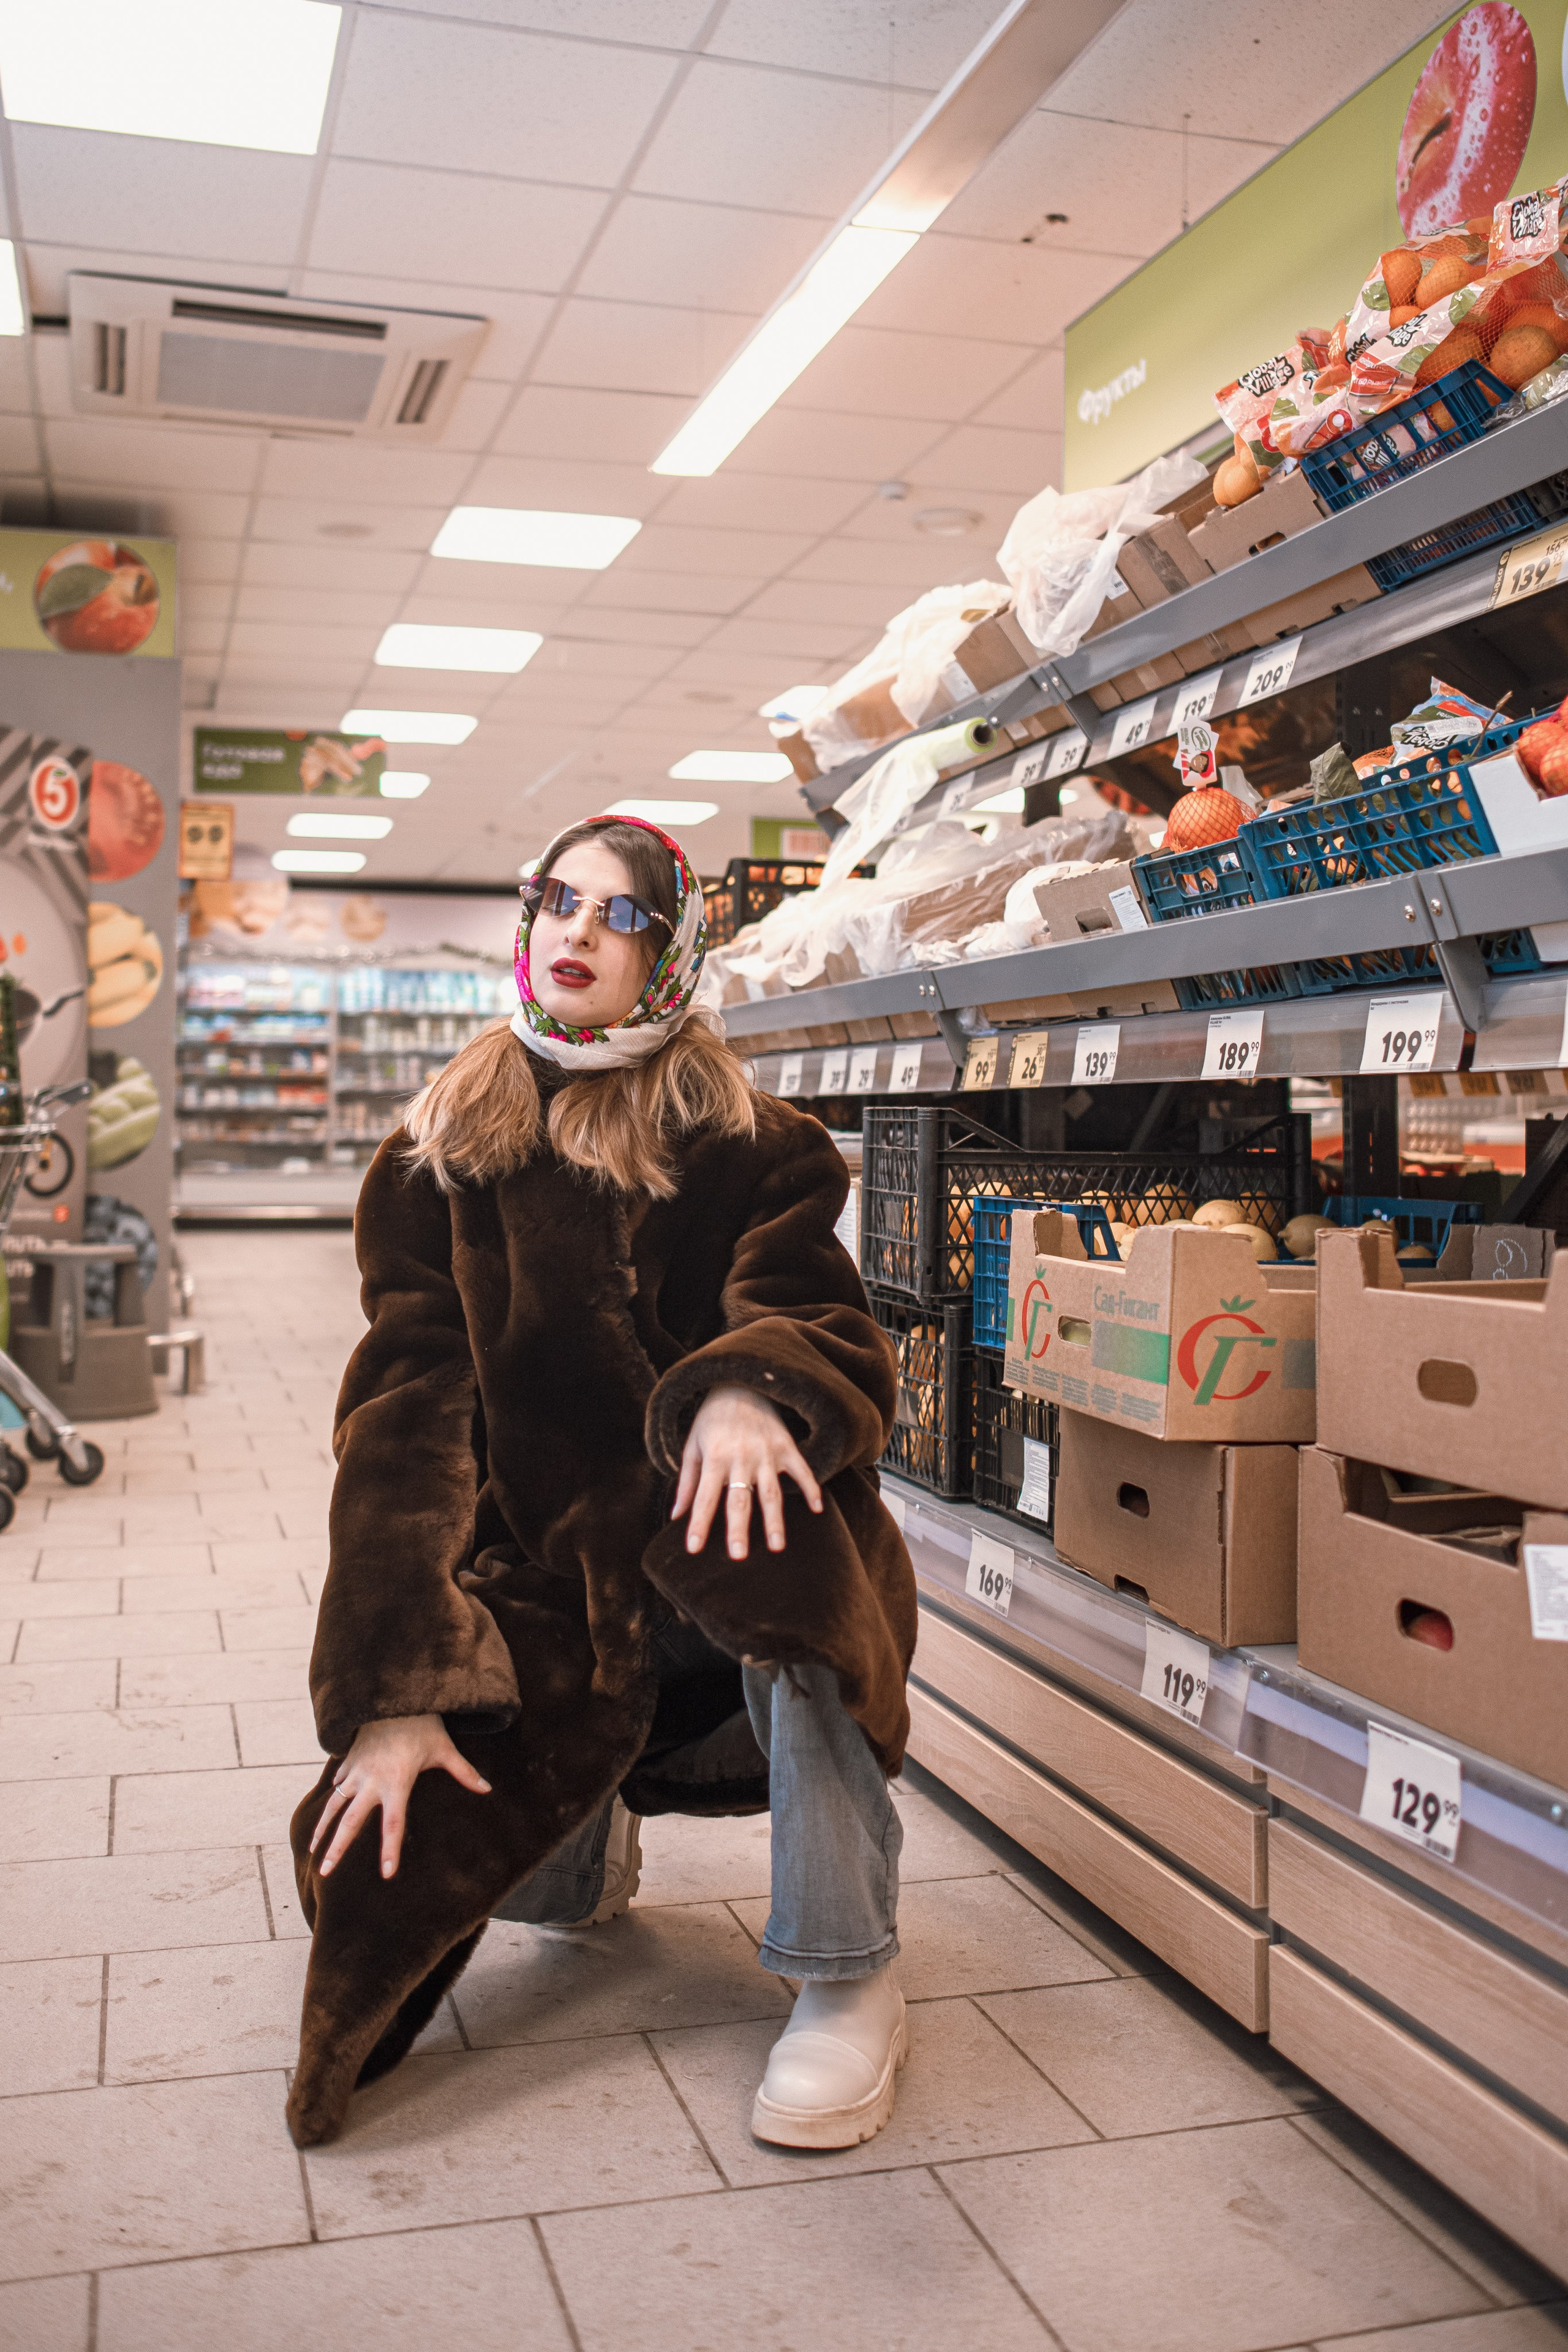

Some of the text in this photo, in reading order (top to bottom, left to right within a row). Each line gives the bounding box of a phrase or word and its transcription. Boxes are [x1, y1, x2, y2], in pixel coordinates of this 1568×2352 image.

[1512, 192, 1544, 219] Global
[1238, 356, 1285, 386] Global
[1247, 365, 1294, 395] Village
[1078, 358, 1145, 425] Фрукты
[1510, 557, 1551, 595] 139
[1250, 665, 1284, 696] 209
[1125, 722, 1144, 744] 49
[1218, 1042, 1260, 1070] 189 99
[1382, 1030, 1436, 1063] 199 99
[901, 1066, 914, 1086] 49
[975, 1061, 989, 1082] 99
[1021, 1057, 1037, 1079] 26
[1085, 1052, 1117, 1077] 139 99
[1094, 1286, 1160, 1322] Сад-Гигант
[979, 1564, 1012, 1601] 169 99
[1164, 1664, 1206, 1707] 119 99
[1392, 1777, 1459, 1834] 129 99
